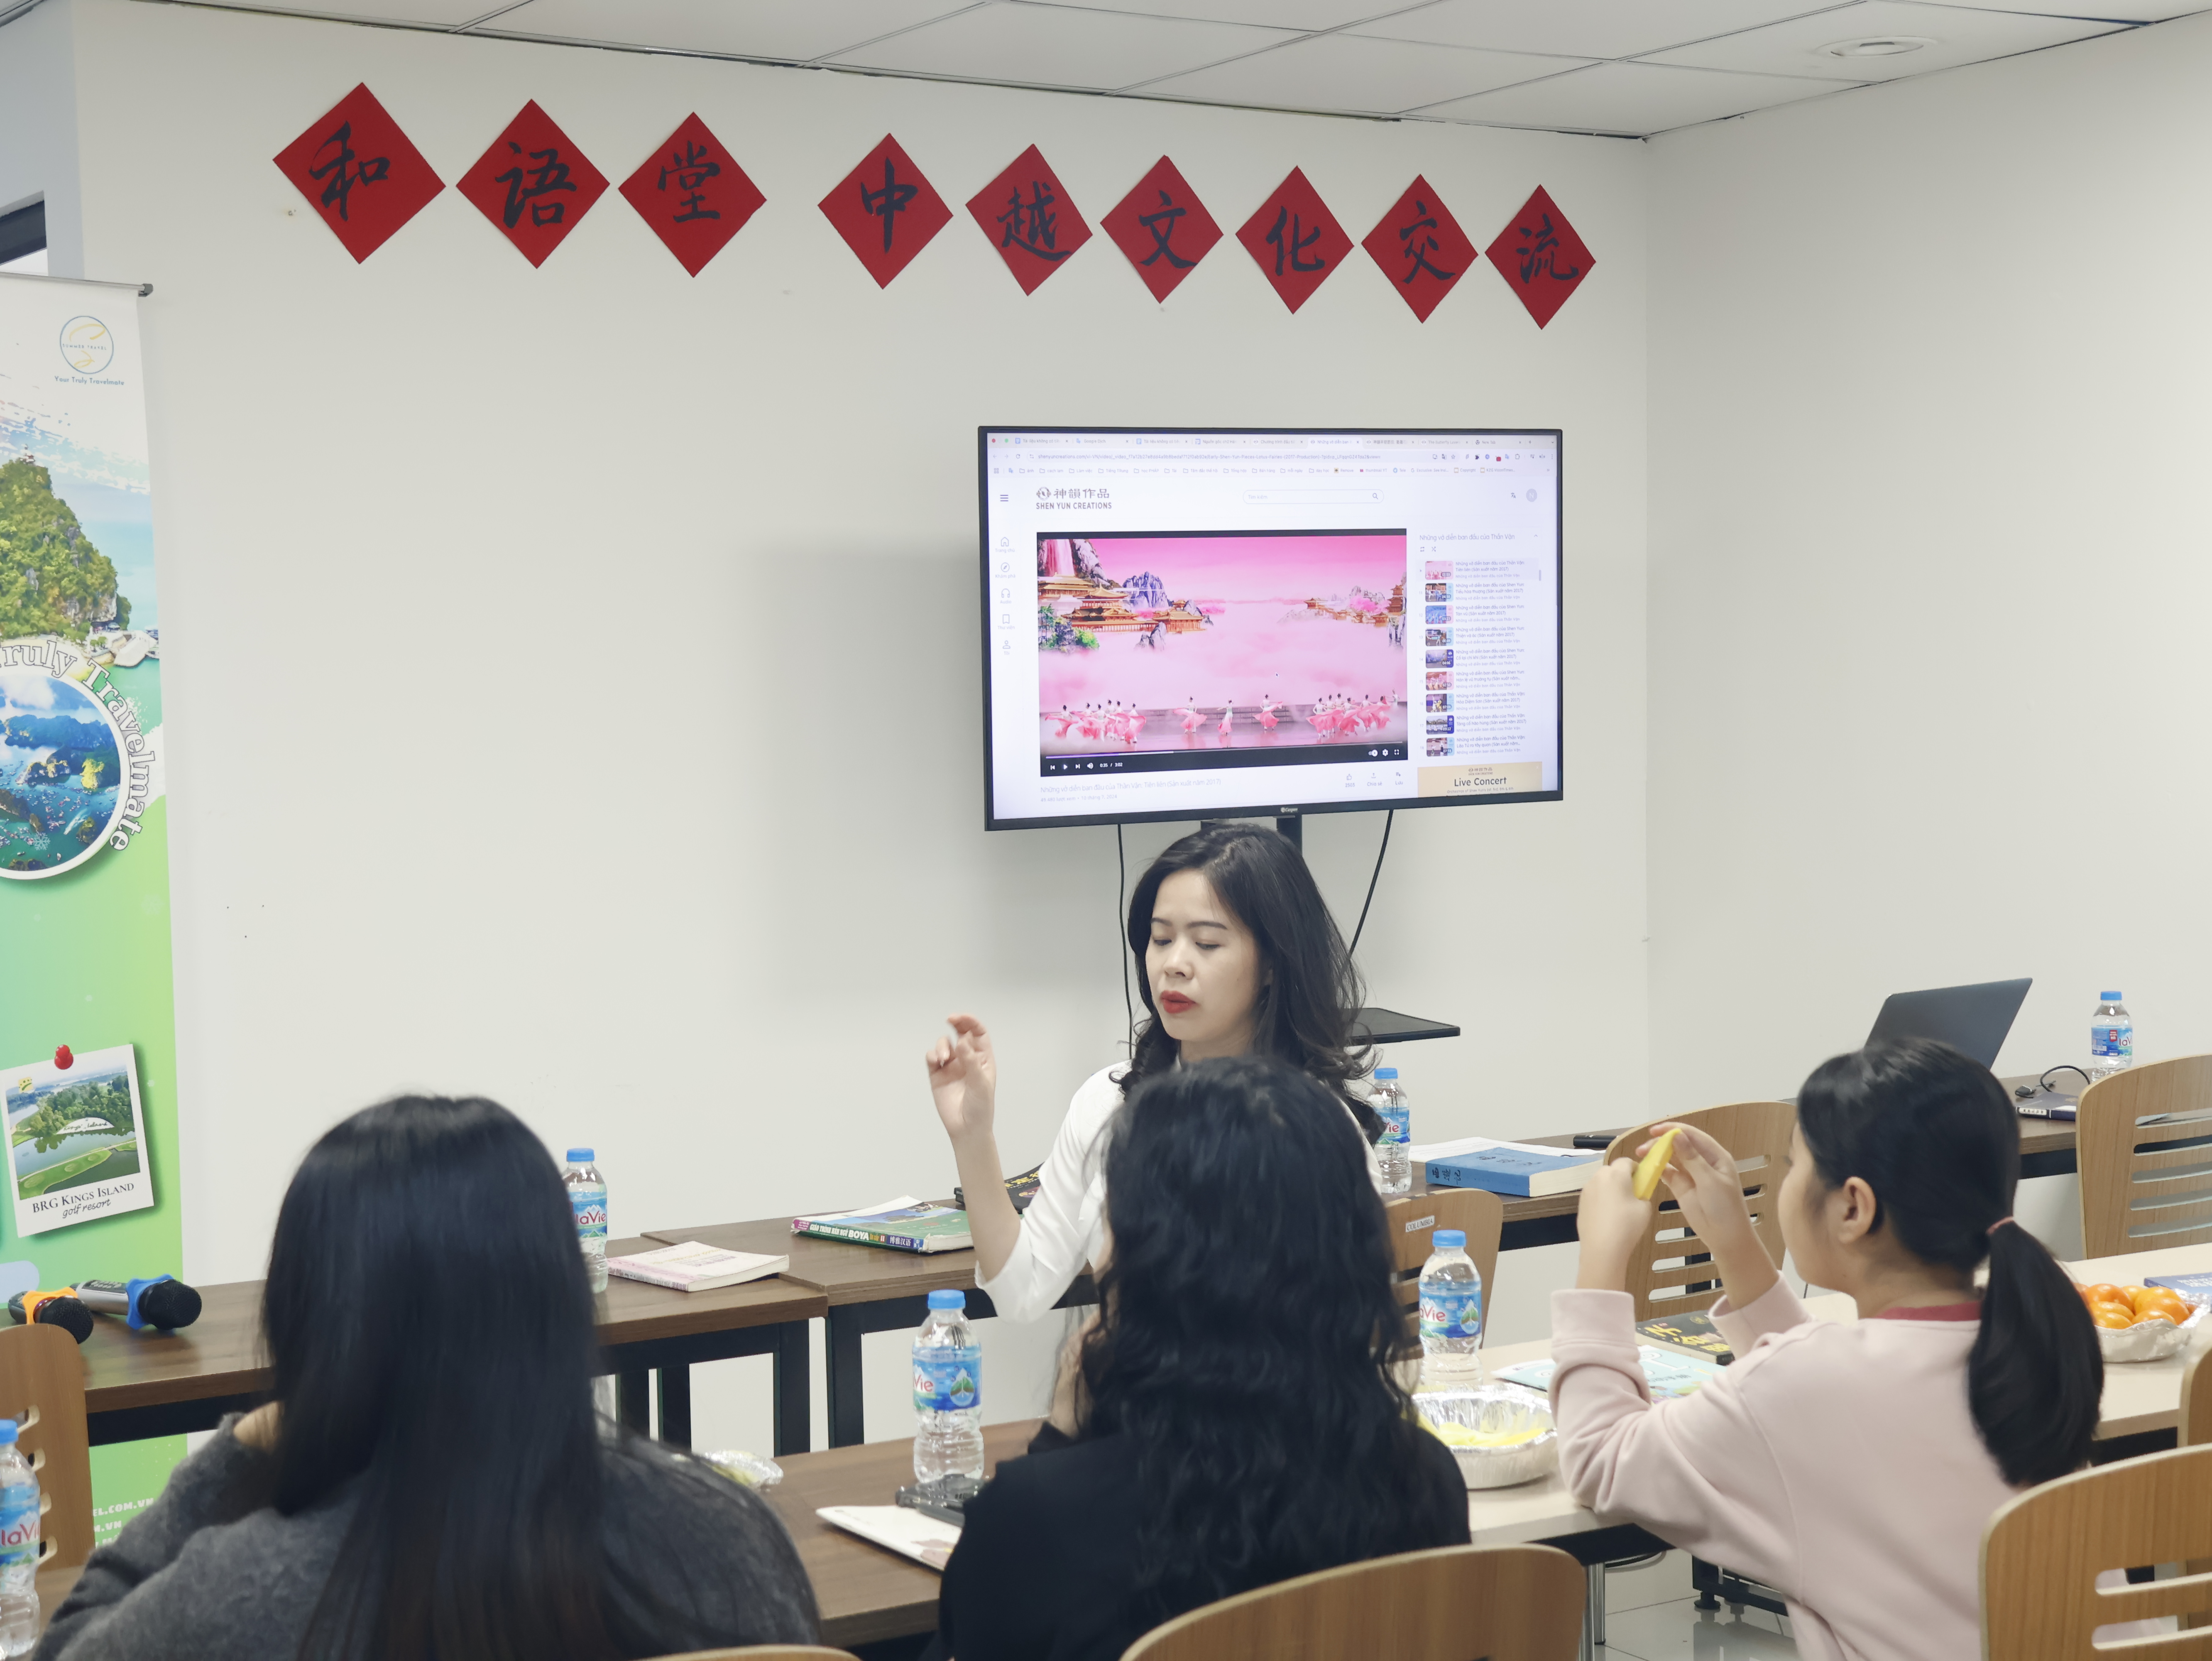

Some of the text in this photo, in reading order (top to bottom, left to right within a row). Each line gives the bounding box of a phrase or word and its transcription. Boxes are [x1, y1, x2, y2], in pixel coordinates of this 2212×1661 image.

[1053, 488, 1109, 499] 神韻作品
[0, 640, 156, 852] ruly Travelmate
[1455, 777, 1507, 786] Live Concert
[2119, 1036, 2132, 1046] laV
[32, 1198, 59, 1213] BRG
[62, 1199, 111, 1218] golf resort
[1407, 1218, 1433, 1231] COLUMBIA
[848, 1230, 869, 1241] BOYA
[890, 1235, 911, 1247] 博雅汉语
[1419, 1303, 1446, 1322] aVie
[913, 1372, 933, 1392] Vie
[93, 1497, 154, 1517] EL.COM.VN
[94, 1520, 122, 1532] M.VN
